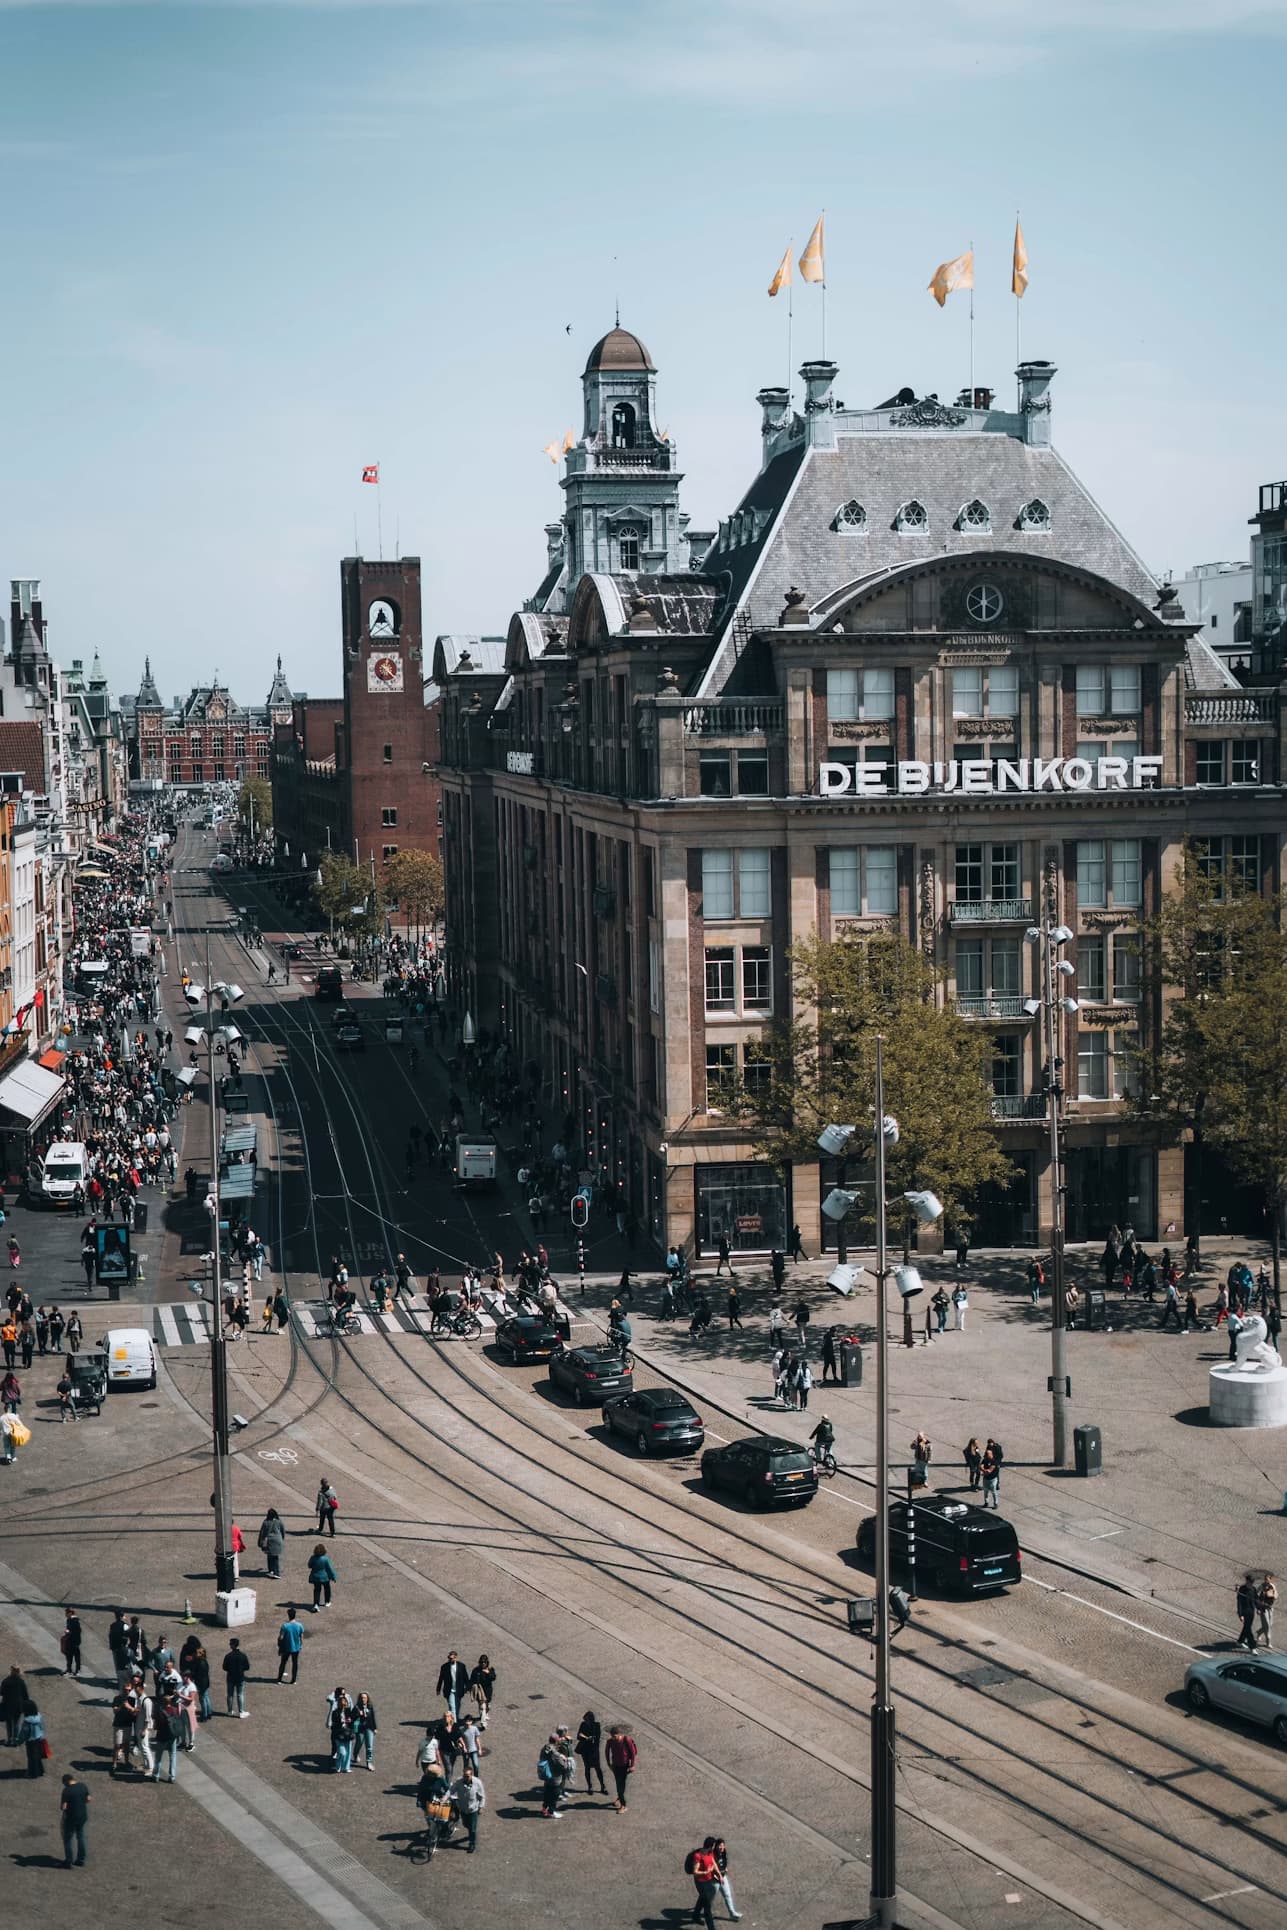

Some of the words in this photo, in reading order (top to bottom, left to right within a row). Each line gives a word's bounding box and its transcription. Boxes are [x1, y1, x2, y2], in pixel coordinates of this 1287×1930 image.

[820, 761, 887, 794] DE
[898, 756, 1163, 793] BIJENKORF
[71, 799, 106, 811] CASINO
